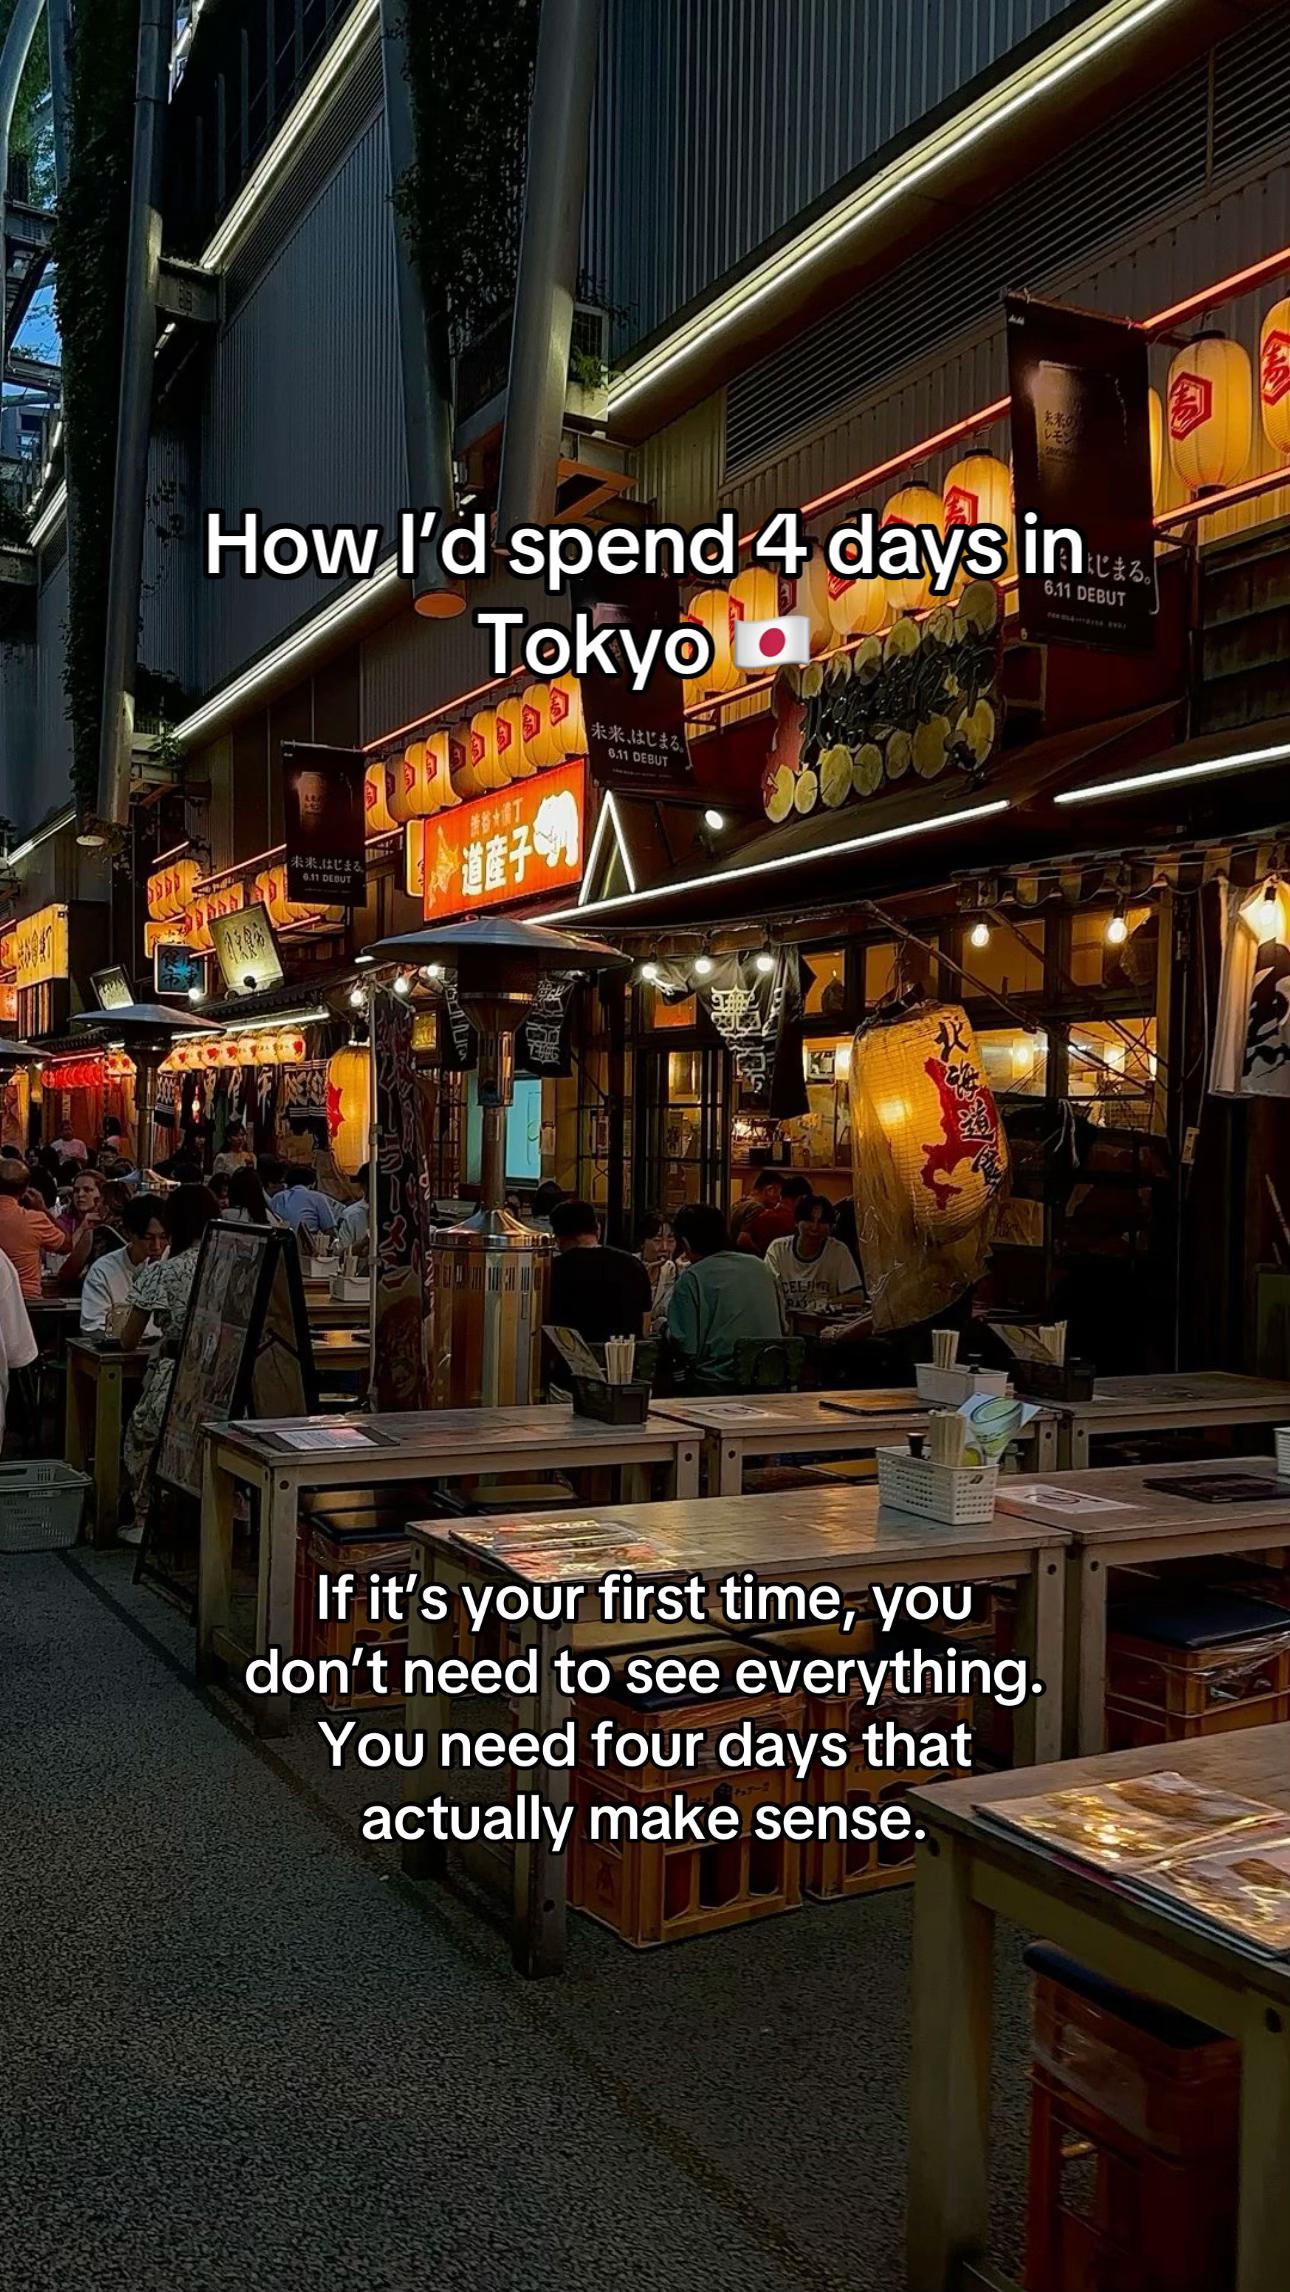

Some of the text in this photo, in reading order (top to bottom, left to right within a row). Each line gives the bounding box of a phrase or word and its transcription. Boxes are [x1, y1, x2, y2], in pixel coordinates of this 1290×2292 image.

[1043, 579, 1126, 607] 6.11 DEBUT
[590, 721, 685, 754] 未来、はじまる。
[632, 751, 670, 768] DEBUT
[290, 853, 364, 874] 未来、はじまる。
[461, 824, 533, 897] 道産子
[322, 874, 353, 885] DEBUT
